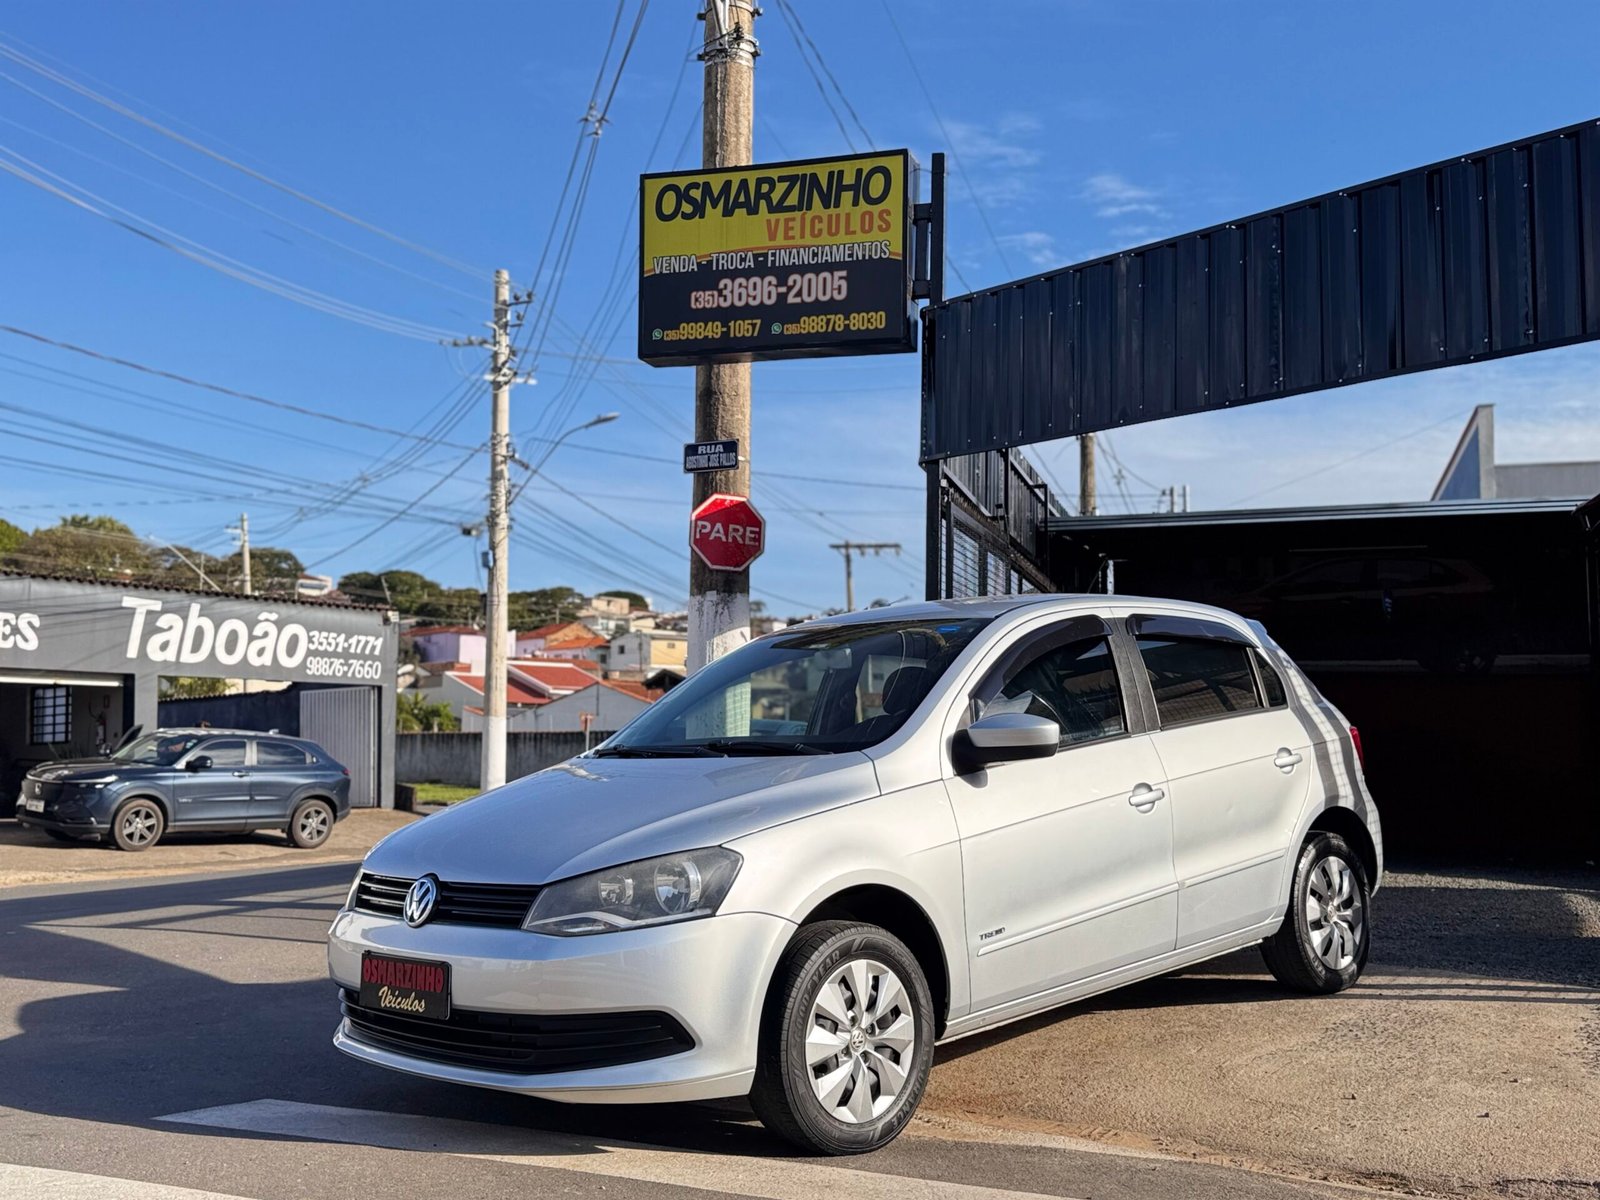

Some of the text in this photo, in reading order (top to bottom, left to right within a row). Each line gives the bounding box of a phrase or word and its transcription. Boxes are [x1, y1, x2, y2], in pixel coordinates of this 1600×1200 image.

[655, 165, 892, 222] OSMARZINHO
[766, 208, 892, 242] VEÍCULOS
[653, 255, 698, 274] VENDA
[711, 251, 755, 271] TROCA
[767, 240, 891, 267] FINANCIAMENTOS
[697, 444, 724, 455] RUA
[695, 520, 760, 546] PARE
[121, 596, 309, 668] Taboão
[363, 958, 444, 993] OSMARZINHO
